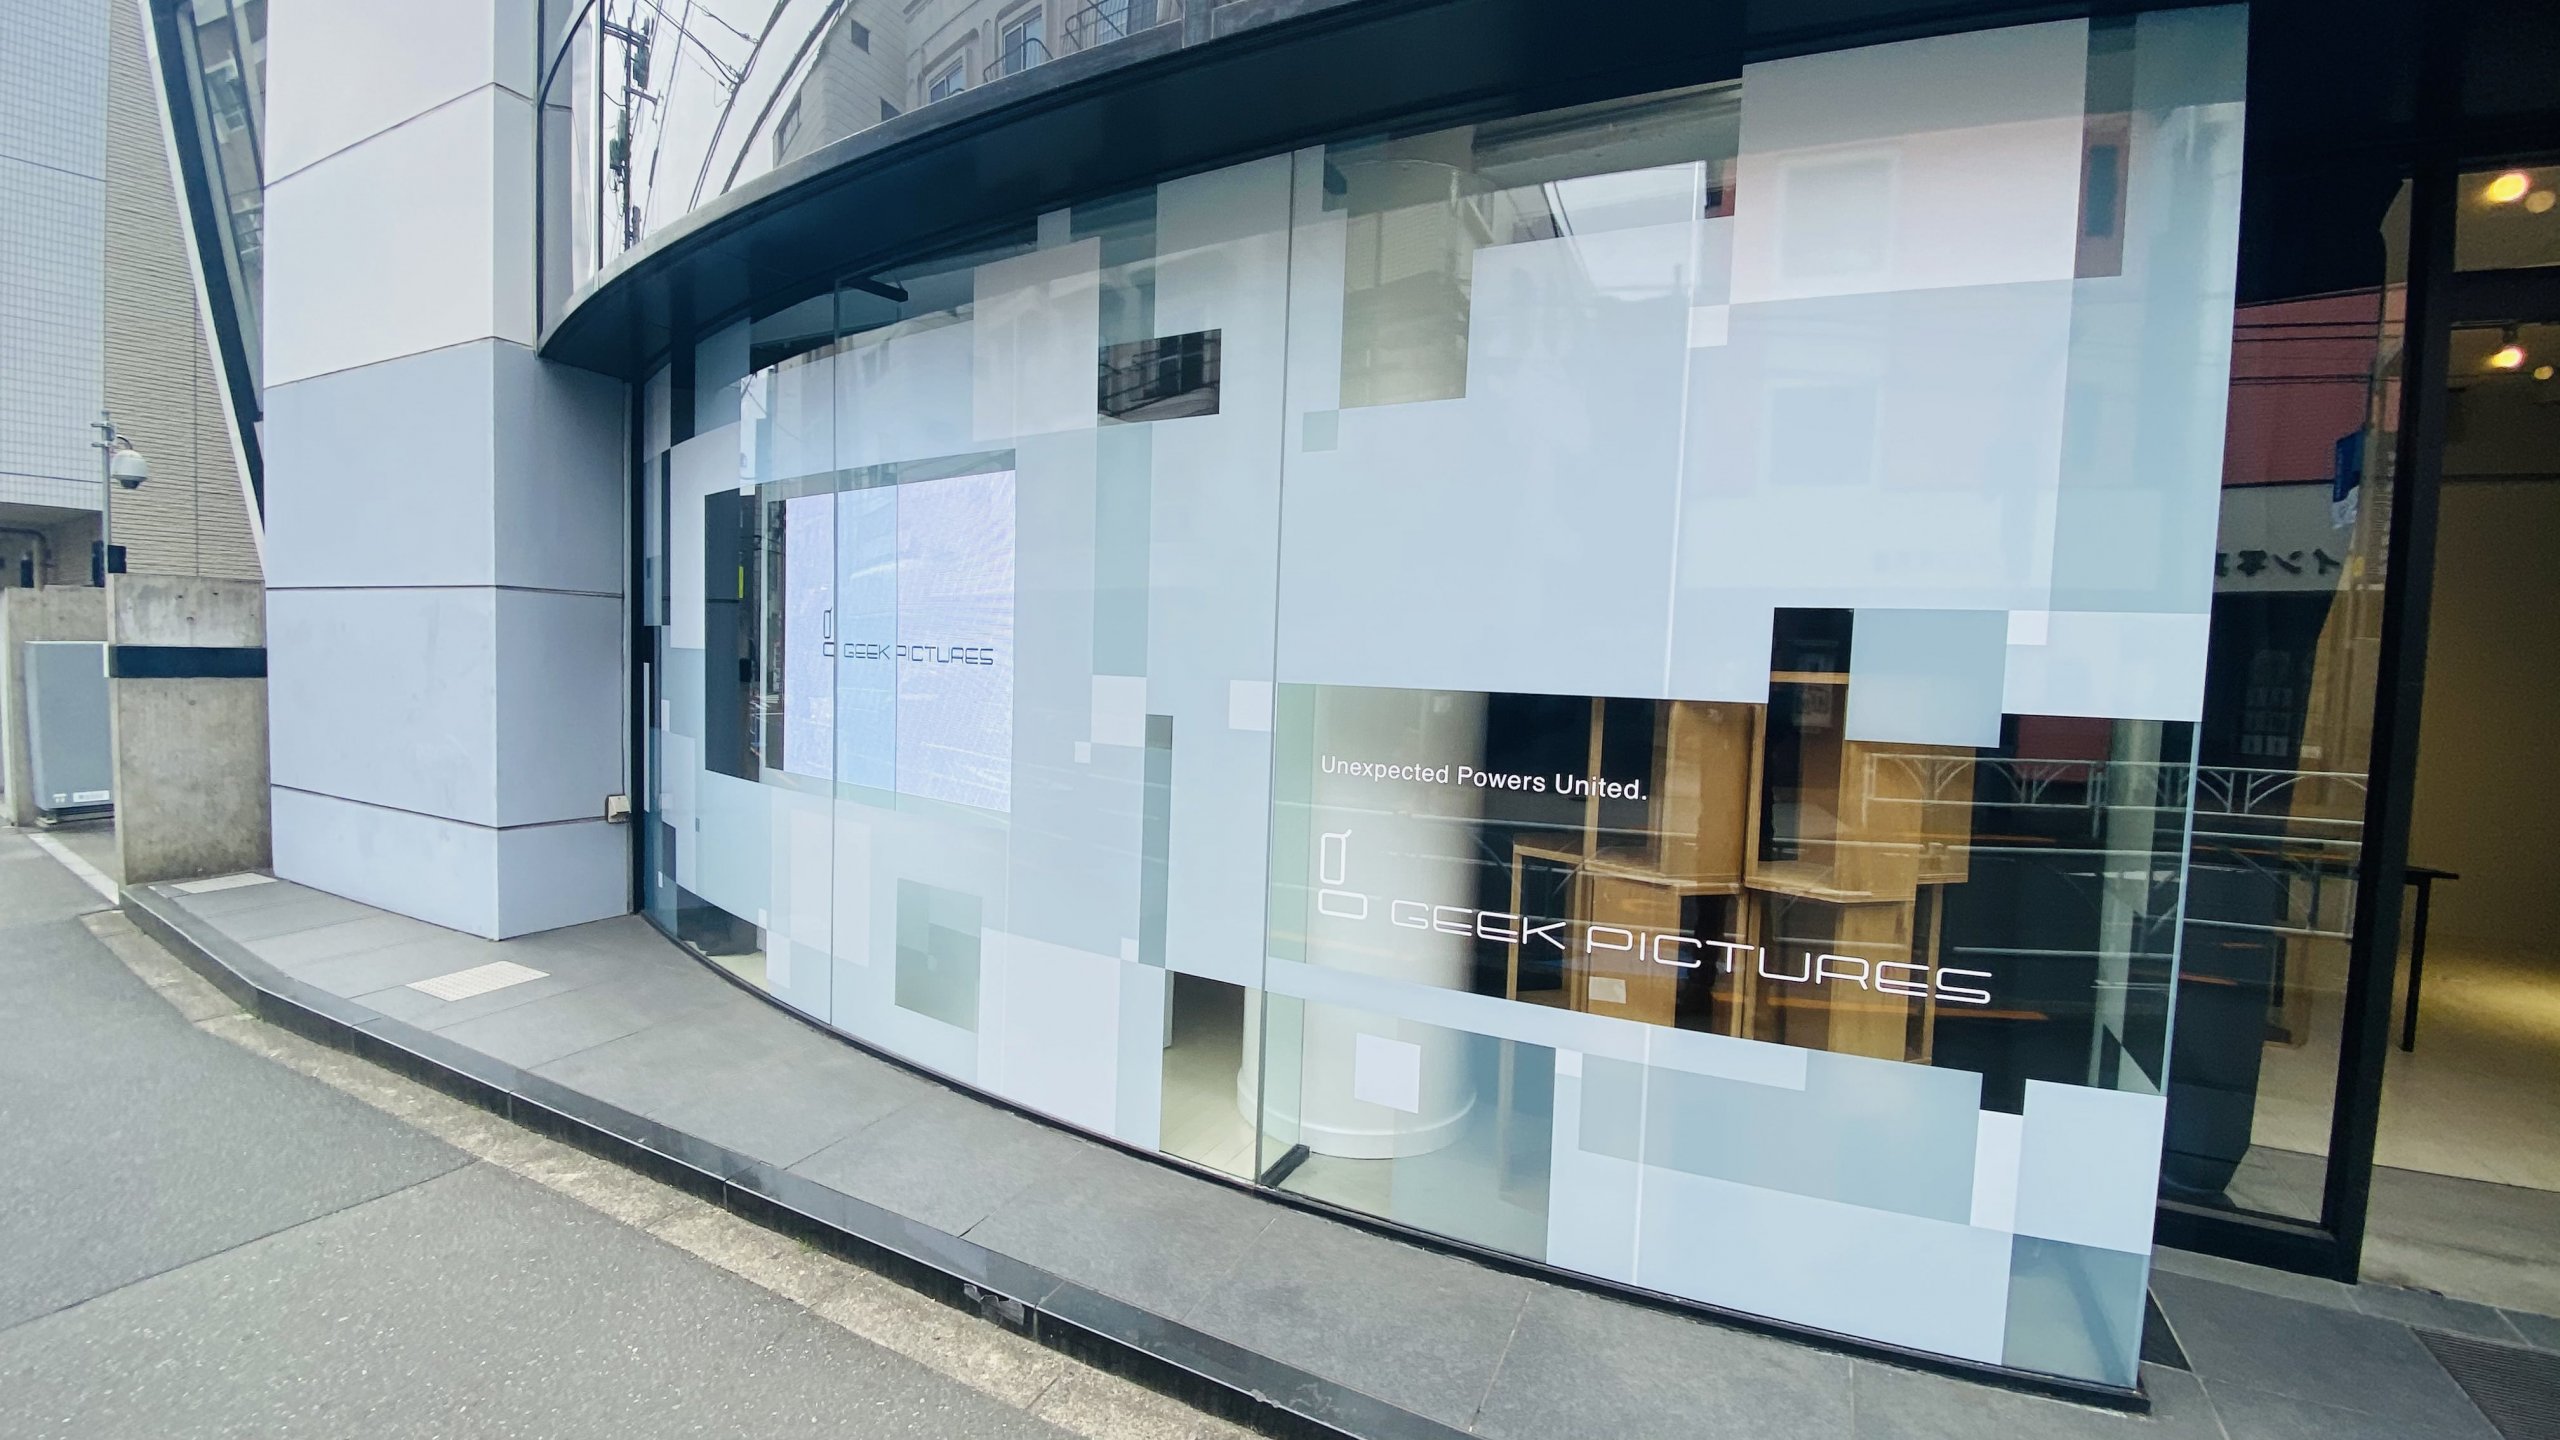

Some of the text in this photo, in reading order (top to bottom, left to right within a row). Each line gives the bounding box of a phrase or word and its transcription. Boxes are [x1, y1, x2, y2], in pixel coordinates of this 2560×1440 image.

[843, 643, 994, 665] GEEK PICTURES
[1321, 755, 1648, 801] Unexpected Powers United.
[1391, 899, 1993, 1005] GEEK PICTURES
